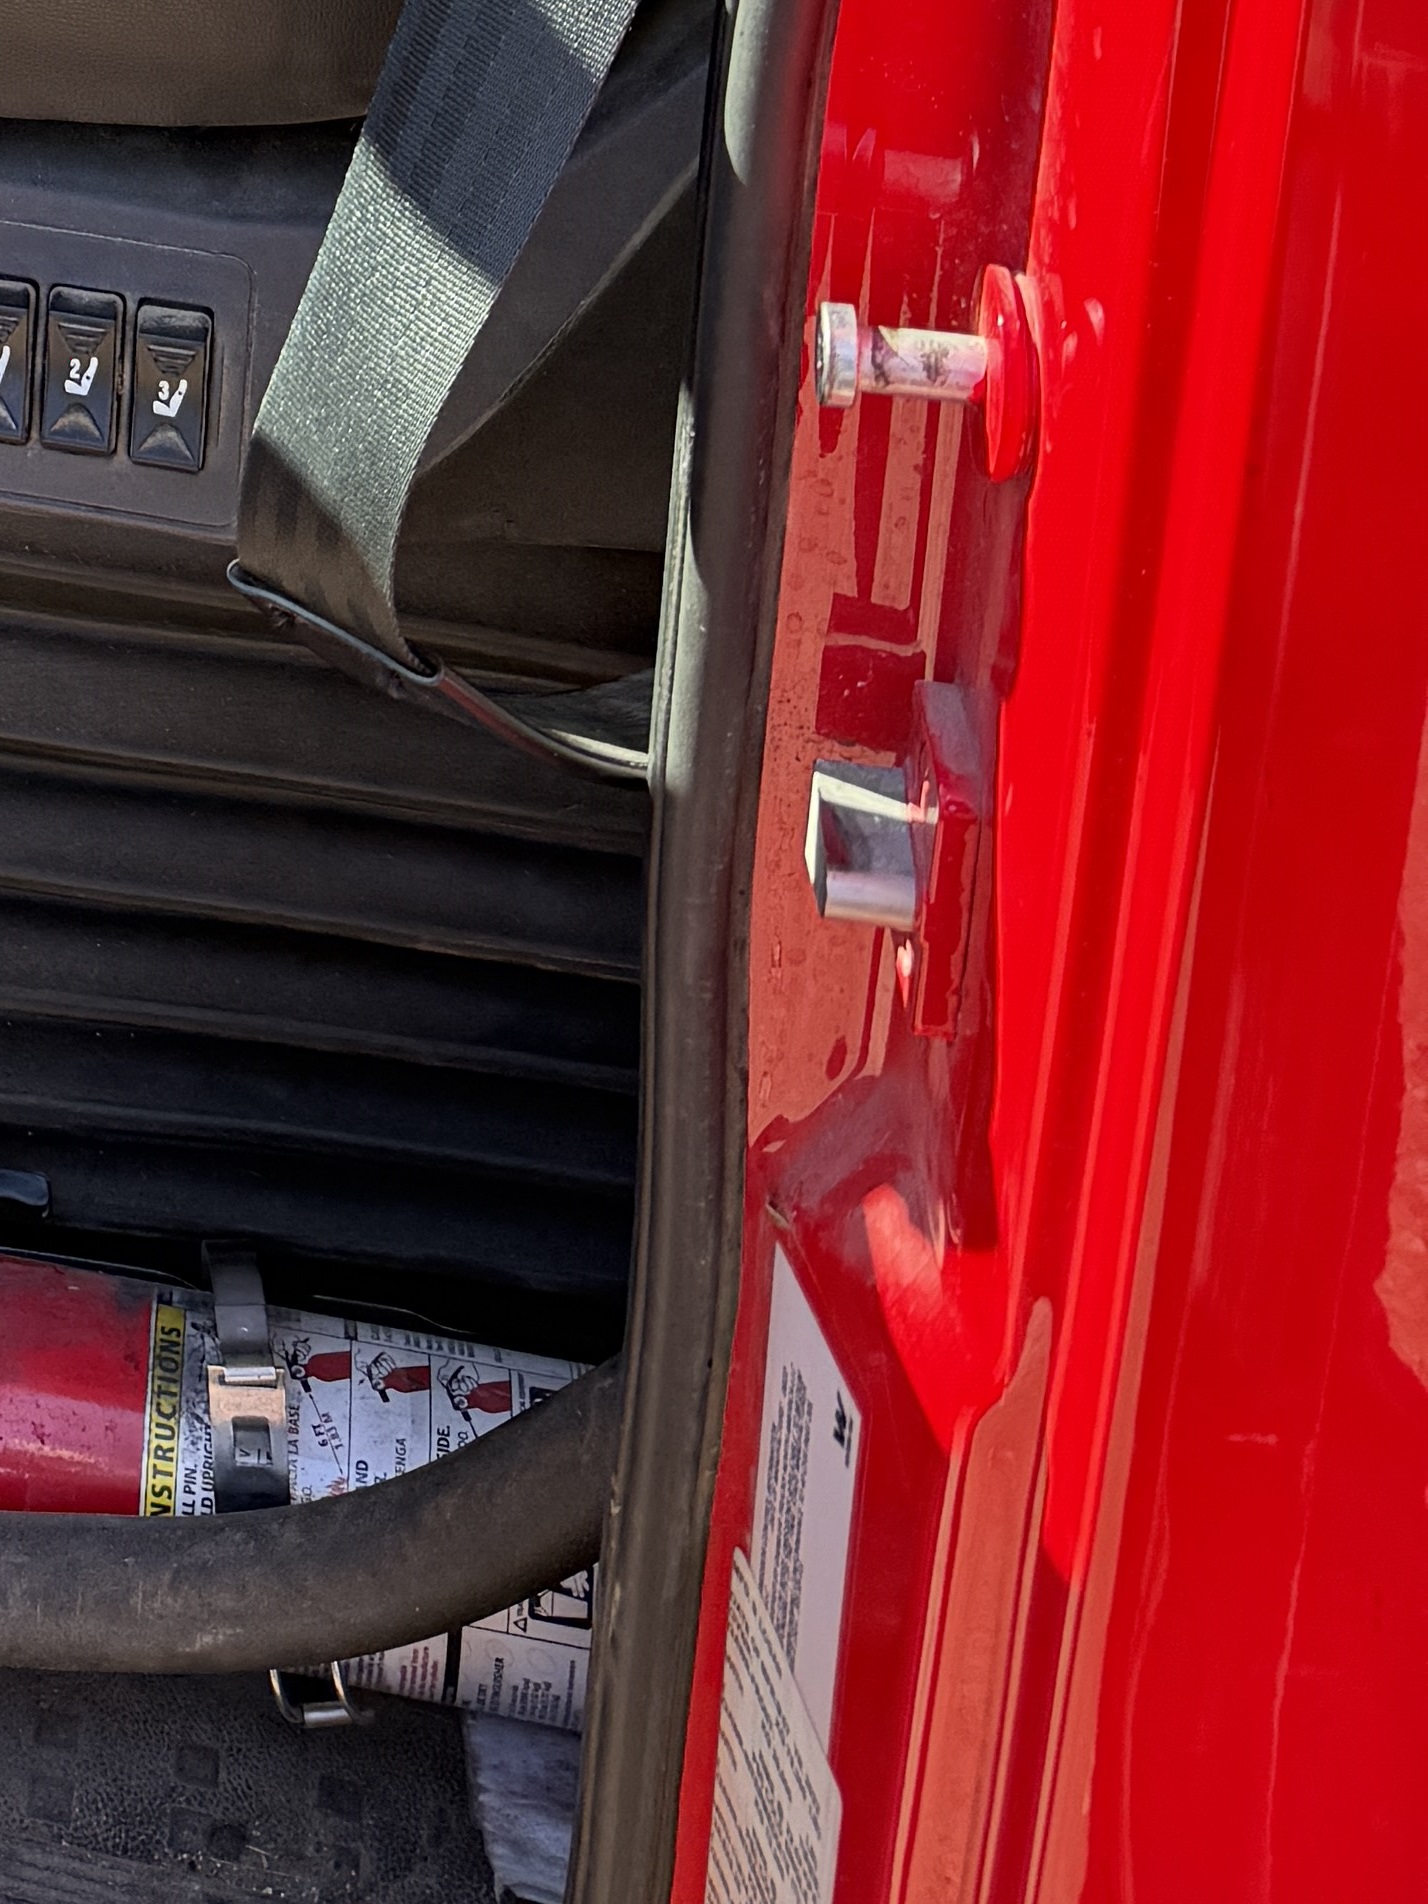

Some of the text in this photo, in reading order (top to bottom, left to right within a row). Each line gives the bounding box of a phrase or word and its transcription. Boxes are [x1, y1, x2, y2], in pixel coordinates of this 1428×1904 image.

[69, 358, 82, 380] 2
[157, 380, 170, 401] 3
[149, 1325, 181, 1516] NSTRUCTIONS
[287, 1404, 300, 1434] BASE
[288, 1438, 299, 1454] LA
[311, 1423, 328, 1446] 6 FT
[183, 1462, 197, 1494] PIN.
[355, 1459, 368, 1483] ND
